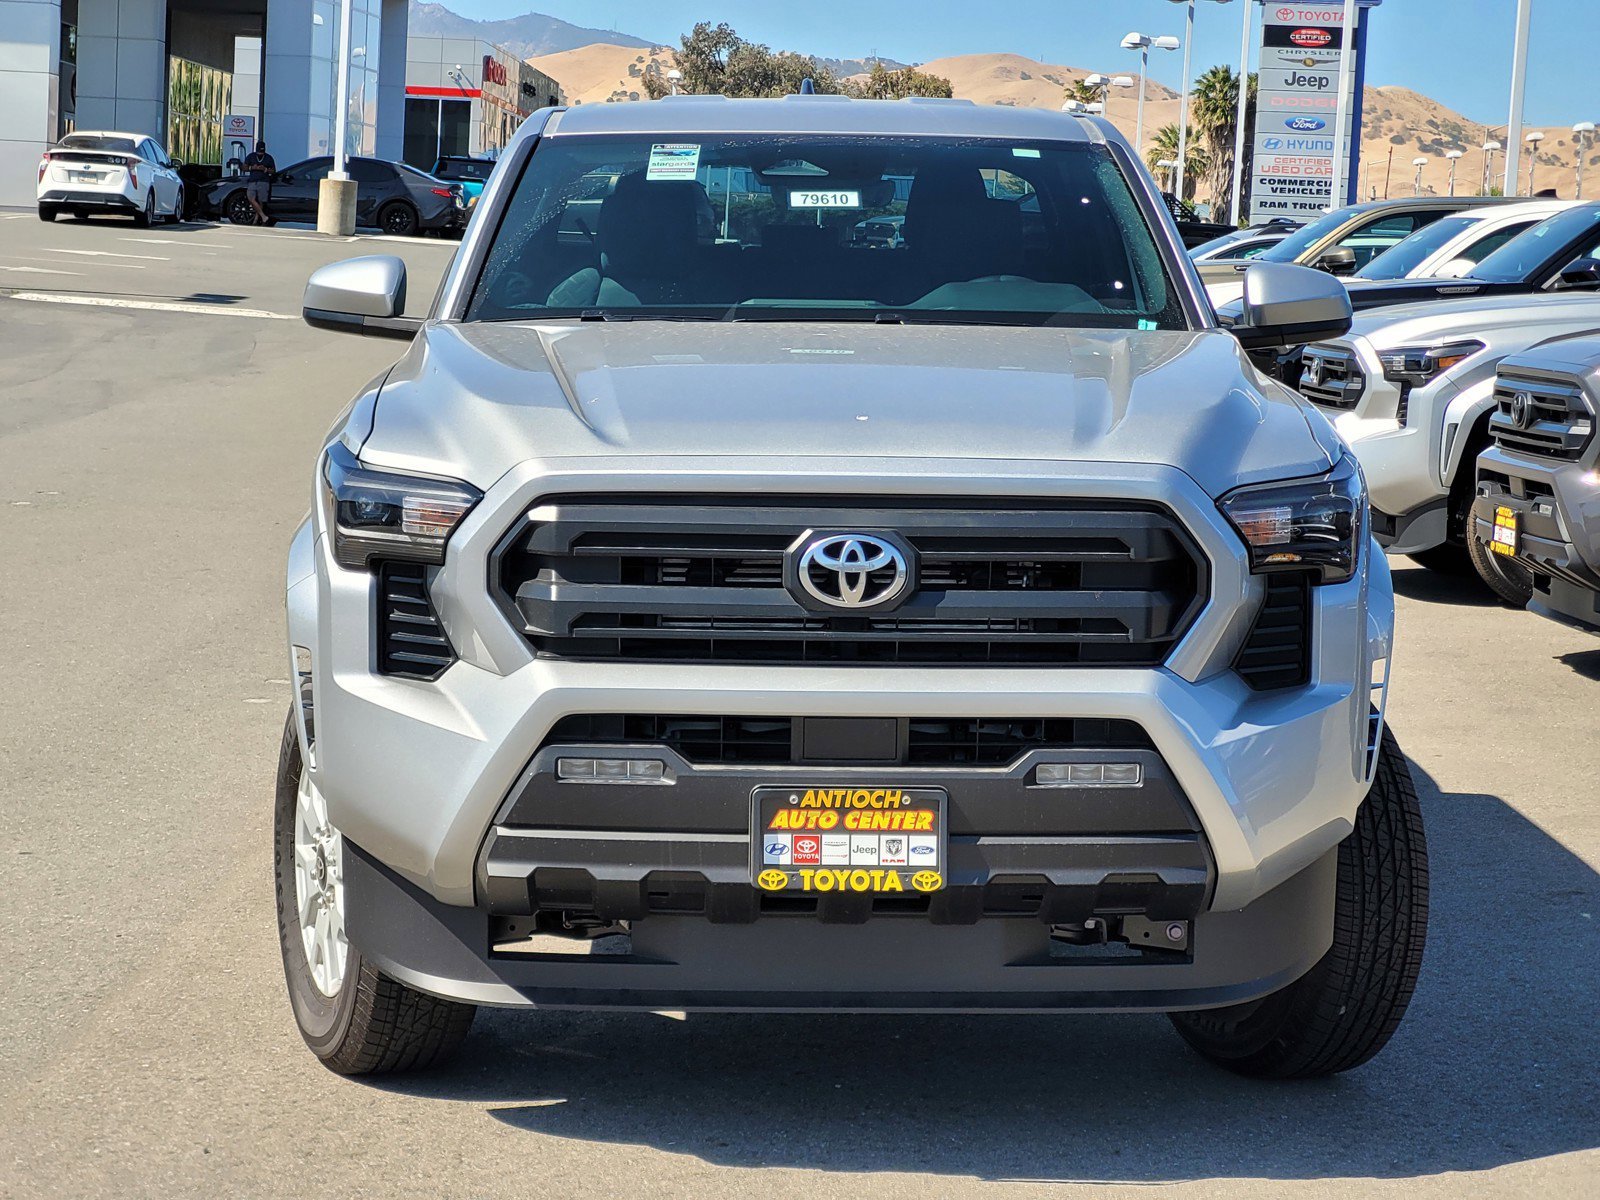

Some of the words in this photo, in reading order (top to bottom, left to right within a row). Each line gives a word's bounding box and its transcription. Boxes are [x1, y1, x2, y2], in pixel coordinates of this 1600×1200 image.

[1284, 71, 1329, 90] Jeep
[1292, 117, 1318, 129] Ford
[1287, 139, 1346, 151] HYUNDI
[1274, 157, 1332, 165] CERTIFIED
[1261, 165, 1300, 174] USED
[1304, 166, 1341, 176] CAR
[1270, 187, 1331, 195] VEHICLES
[800, 194, 849, 205] 79610
[1259, 201, 1288, 209] RAM
[800, 790, 902, 809] ANTIOCH
[768, 809, 840, 830] AUTO
[844, 809, 935, 831] CENTER
[852, 845, 877, 855] Jeep
[800, 869, 903, 891] TOYOTA
